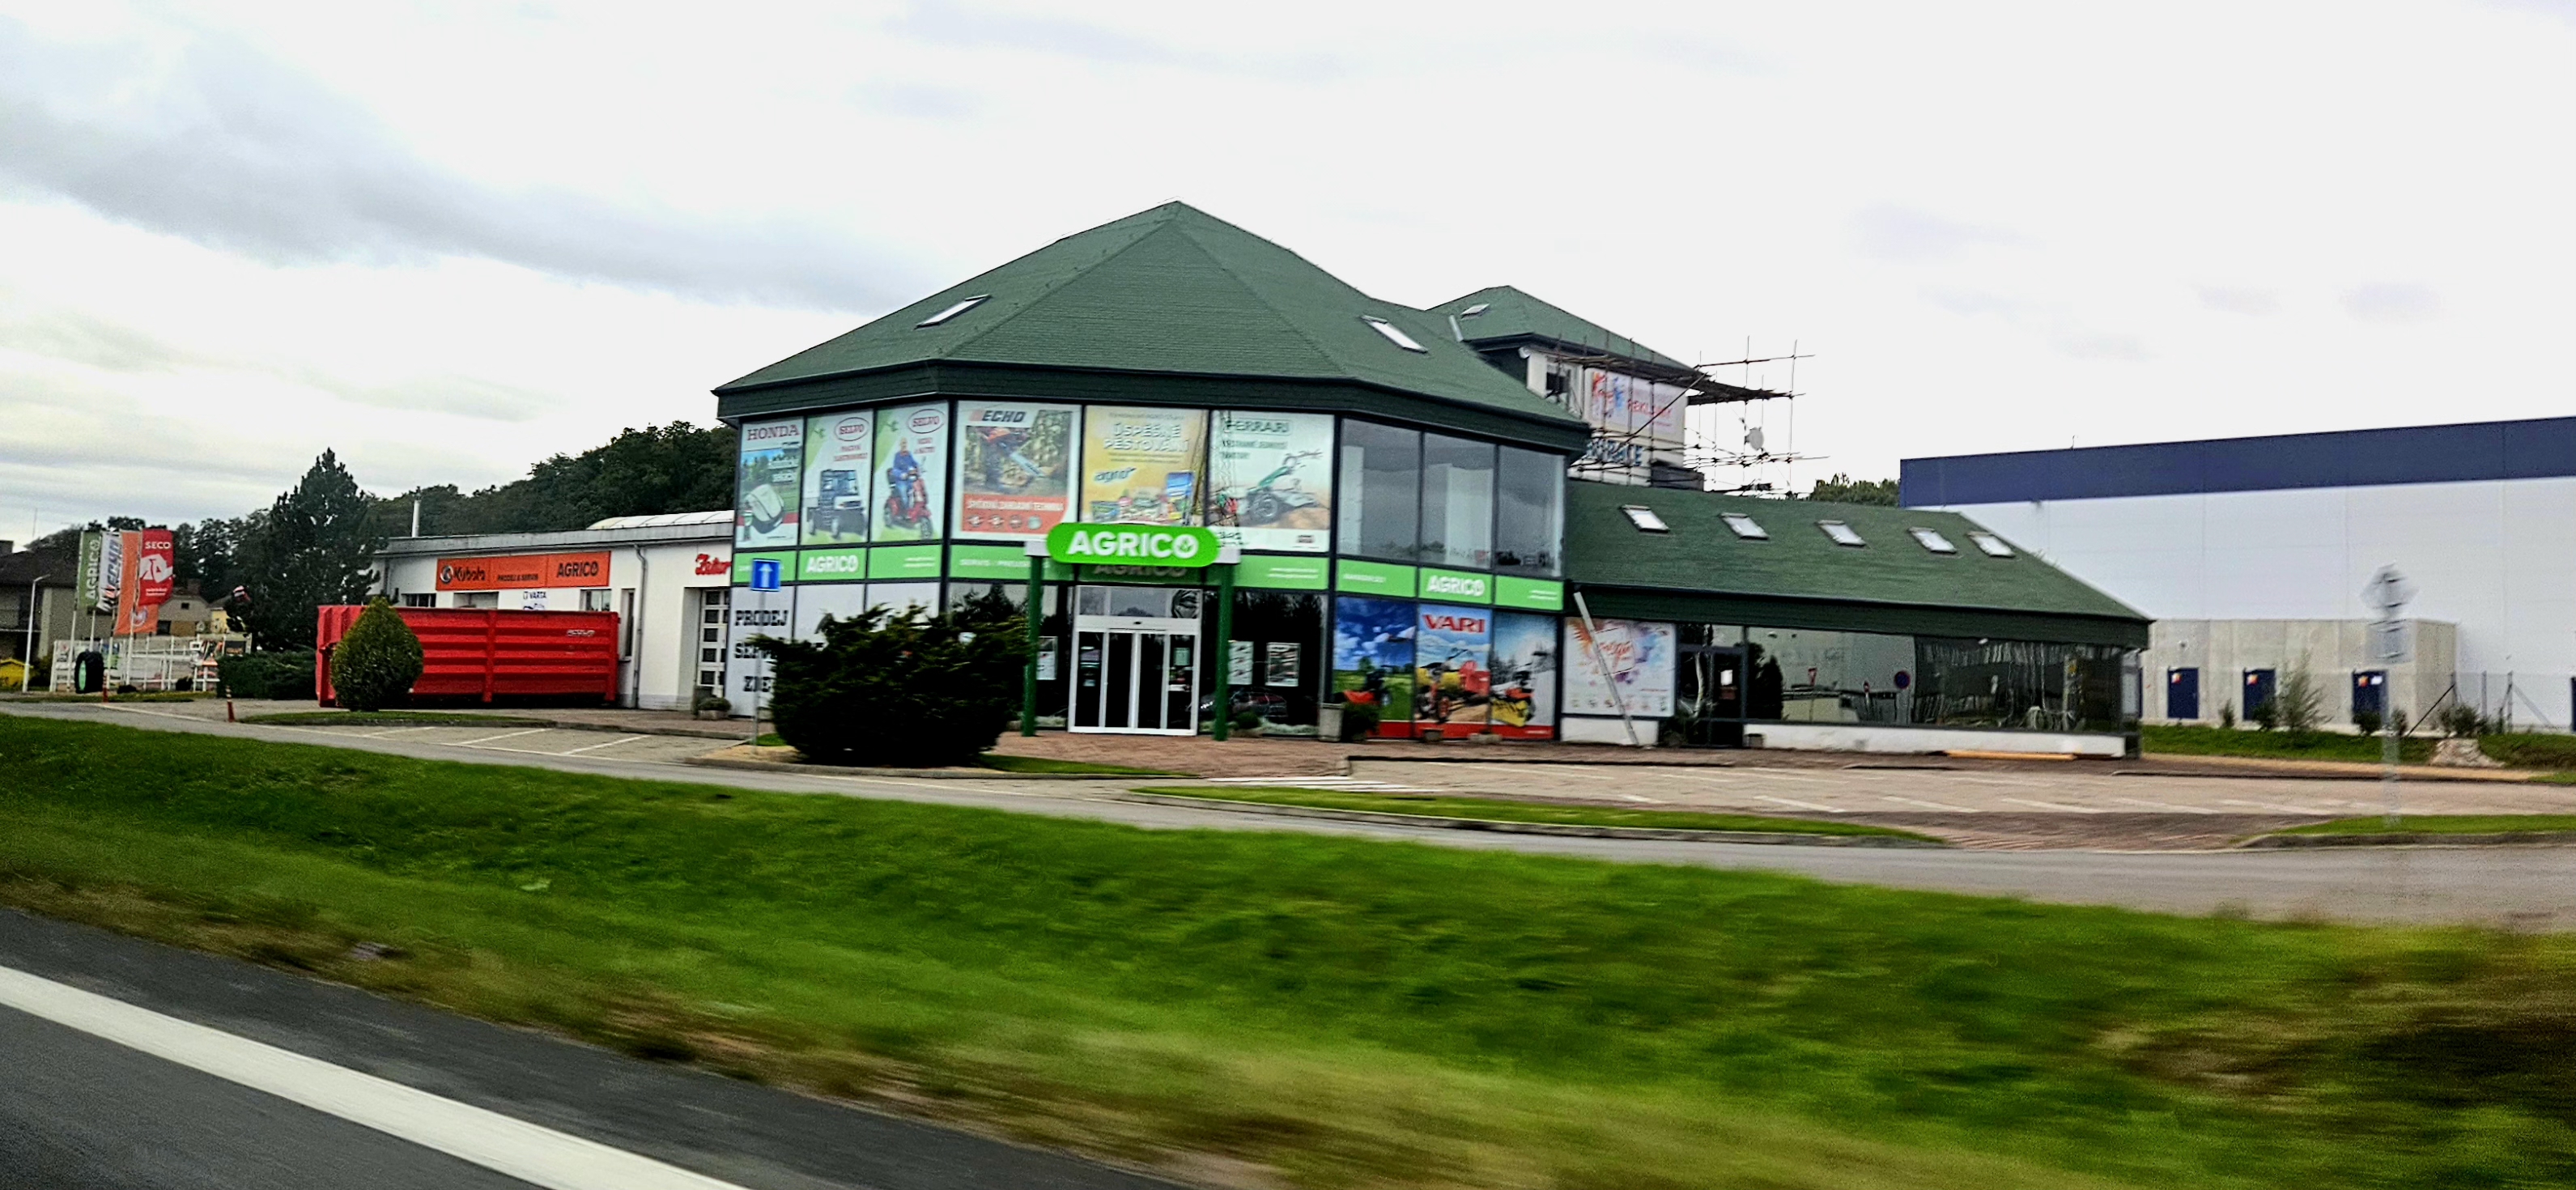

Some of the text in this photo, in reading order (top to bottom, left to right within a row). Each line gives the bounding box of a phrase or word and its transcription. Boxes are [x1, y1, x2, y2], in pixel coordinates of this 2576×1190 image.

[982, 410, 1027, 422] ECHO
[746, 424, 800, 440] HONDA
[145, 542, 171, 550] SECO
[1067, 530, 1199, 559] AGRICO
[85, 539, 100, 601] AGRICO
[557, 561, 599, 578] AGRICO
[806, 555, 858, 573] AGRICO
[1426, 575, 1485, 597] AGRICO
[734, 610, 789, 627] PRODEJ
[1422, 614, 1486, 633] VARI
